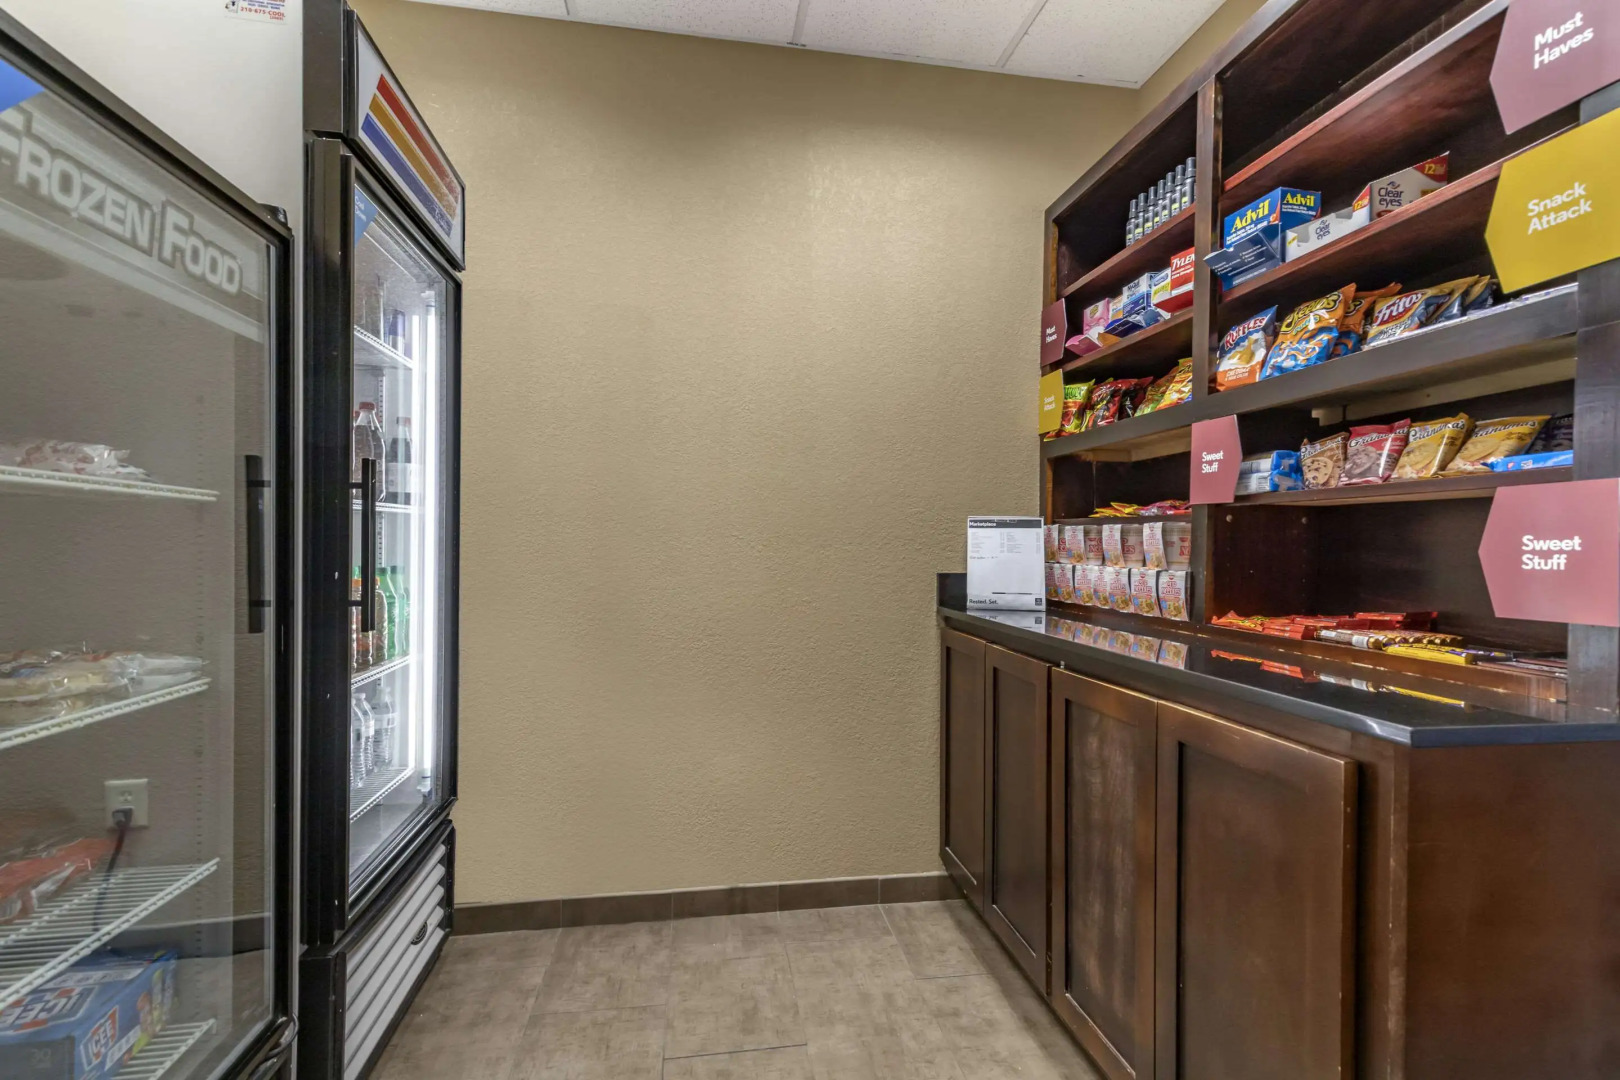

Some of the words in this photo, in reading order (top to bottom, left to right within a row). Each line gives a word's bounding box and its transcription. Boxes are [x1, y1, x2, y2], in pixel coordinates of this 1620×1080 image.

[1534, 11, 1583, 51] Must
[1534, 27, 1594, 69] Haves
[1282, 193, 1315, 207] Advil
[1378, 187, 1404, 198] Clear
[1527, 182, 1587, 216] Snack
[1379, 197, 1402, 208] eyes
[1231, 199, 1271, 233] Advil
[1527, 198, 1592, 235] Attack
[1315, 224, 1331, 236] Clear
[1316, 230, 1331, 241] eyes
[1373, 291, 1425, 329] Fritos
[1225, 317, 1267, 351] RUFFLES
[1202, 450, 1224, 462] Sweet
[1202, 462, 1219, 474] Stuff
[1521, 535, 1582, 551] Sweet
[1521, 554, 1567, 570] Stuff
[88, 1017, 113, 1061] ICEE
